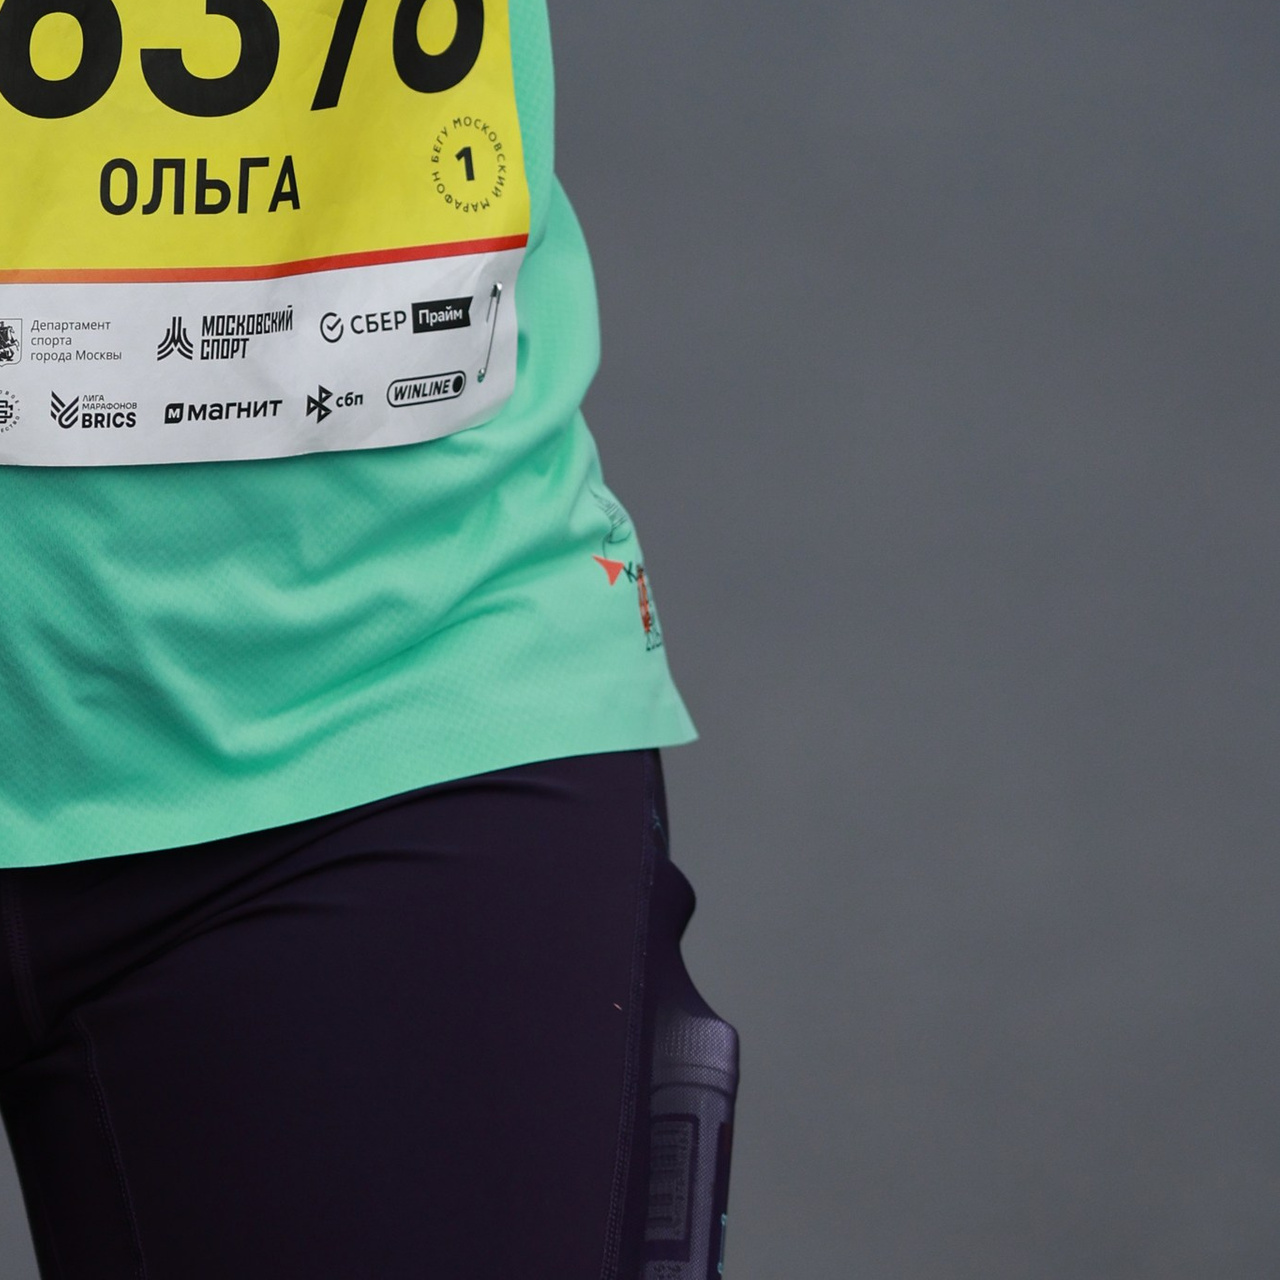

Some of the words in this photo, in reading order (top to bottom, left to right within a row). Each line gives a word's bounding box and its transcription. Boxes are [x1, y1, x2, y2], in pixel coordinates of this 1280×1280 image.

[431, 126, 448, 163] БЕГУ
[452, 116, 507, 198] МОСКОВСКИЙ
[455, 146, 475, 182] 1
[99, 155, 300, 216] ОЛЬГА
[431, 171, 490, 213] МАРАФОН
[30, 319, 111, 333] Департамент
[201, 305, 293, 336] МОСКОВСКИЙ
[350, 310, 407, 334] СБЕР
[418, 306, 463, 327] Прайм
[30, 336, 72, 348] спорта
[200, 338, 250, 360] СПОРТ
[30, 351, 72, 363] города
[75, 350, 122, 361] Москвы
[82, 394, 105, 402] ЛИГА
[336, 392, 364, 408] сбп
[393, 379, 452, 402] WINLINE
[81, 402, 138, 410] МАРАФОНОВ
[187, 399, 283, 421] магнит
[81, 411, 137, 428] BRICS
